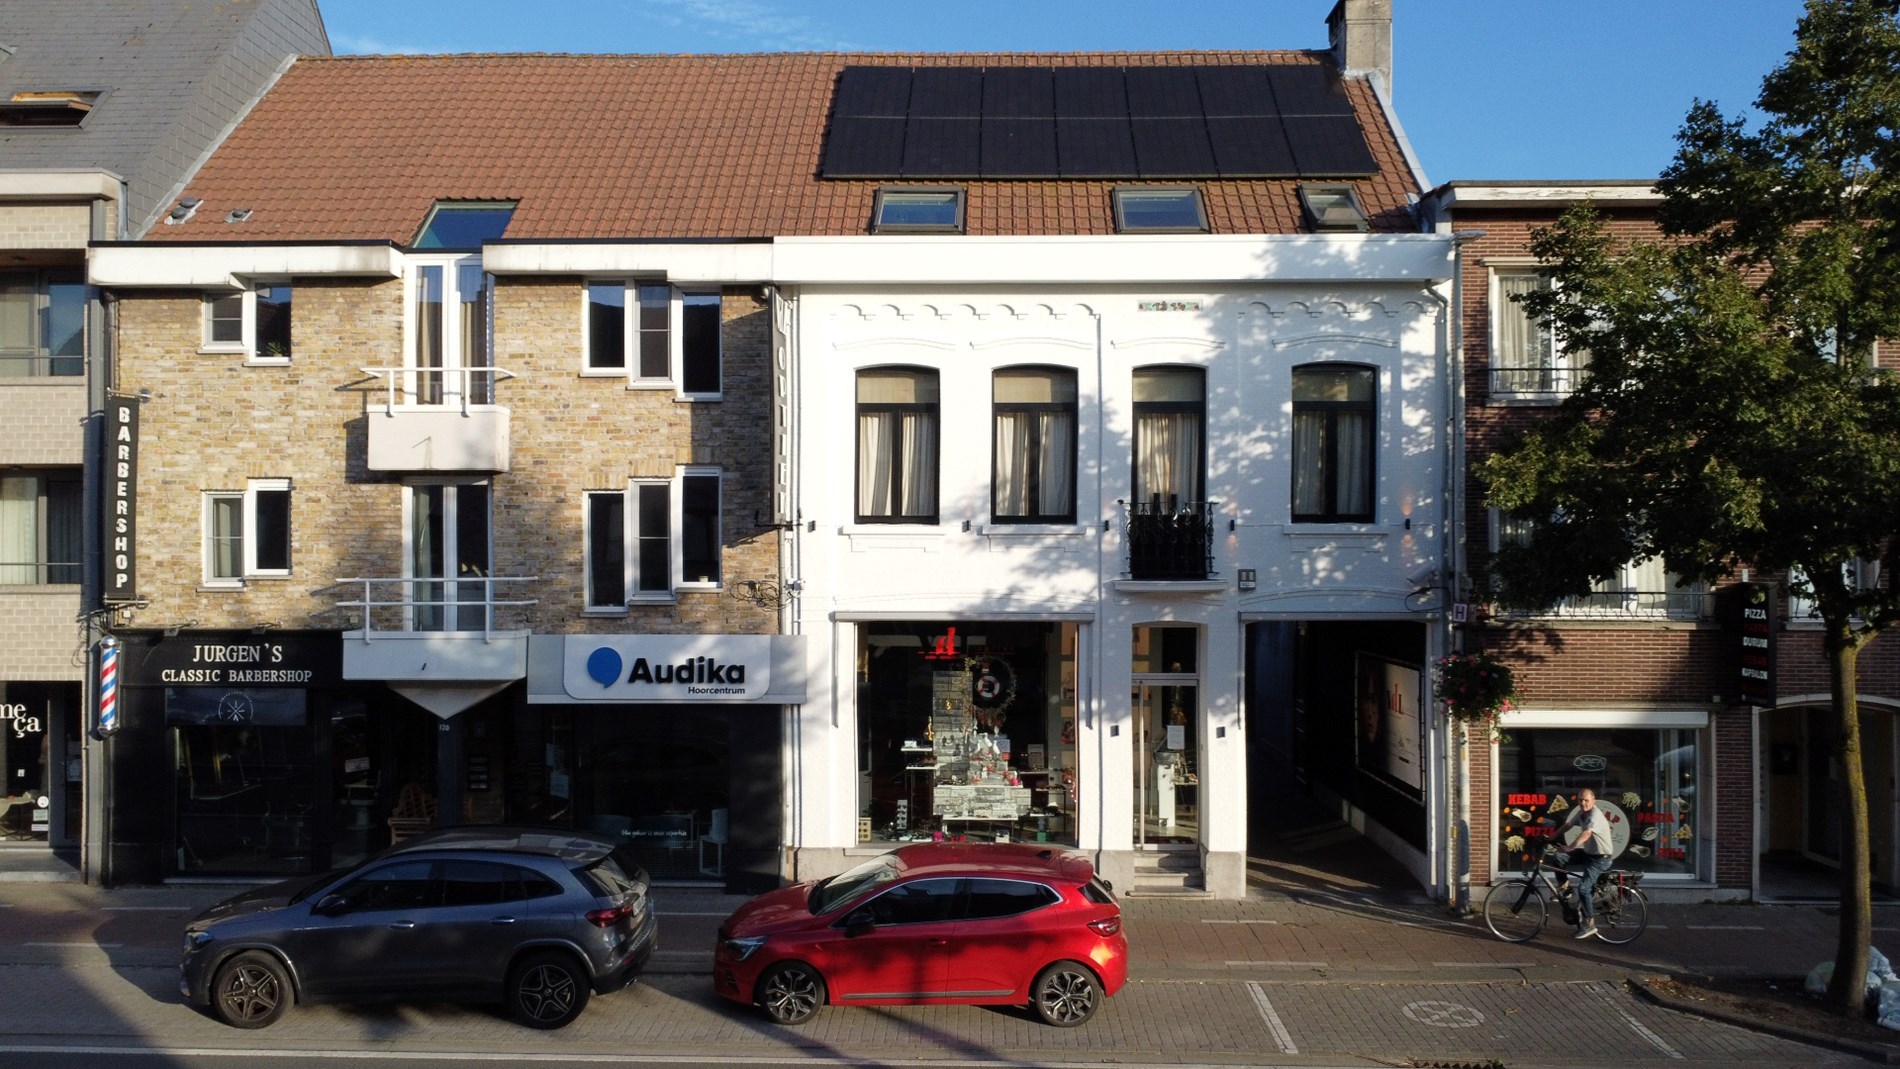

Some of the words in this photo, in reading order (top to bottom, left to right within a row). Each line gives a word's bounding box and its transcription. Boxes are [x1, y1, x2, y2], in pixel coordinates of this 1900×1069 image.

[114, 405, 131, 589] BARBERSHOP
[1744, 608, 1767, 620] PIZZA
[1742, 636, 1768, 649] DURUM
[192, 643, 283, 663] JURGEN'S
[161, 669, 221, 683] CLASSIC
[228, 669, 312, 683] BARBERSHOP
[627, 655, 746, 685] Audika
[1741, 667, 1768, 681] KAPSALON
[688, 686, 746, 696] Hoorcentrum
[13, 716, 42, 739] ça
[1574, 757, 1605, 768] OPEN
[1507, 794, 1547, 806] KEBAB
[1637, 812, 1675, 824] PASTA
[1524, 826, 1557, 838] PIZZA
[1657, 848, 1686, 860] PITA
